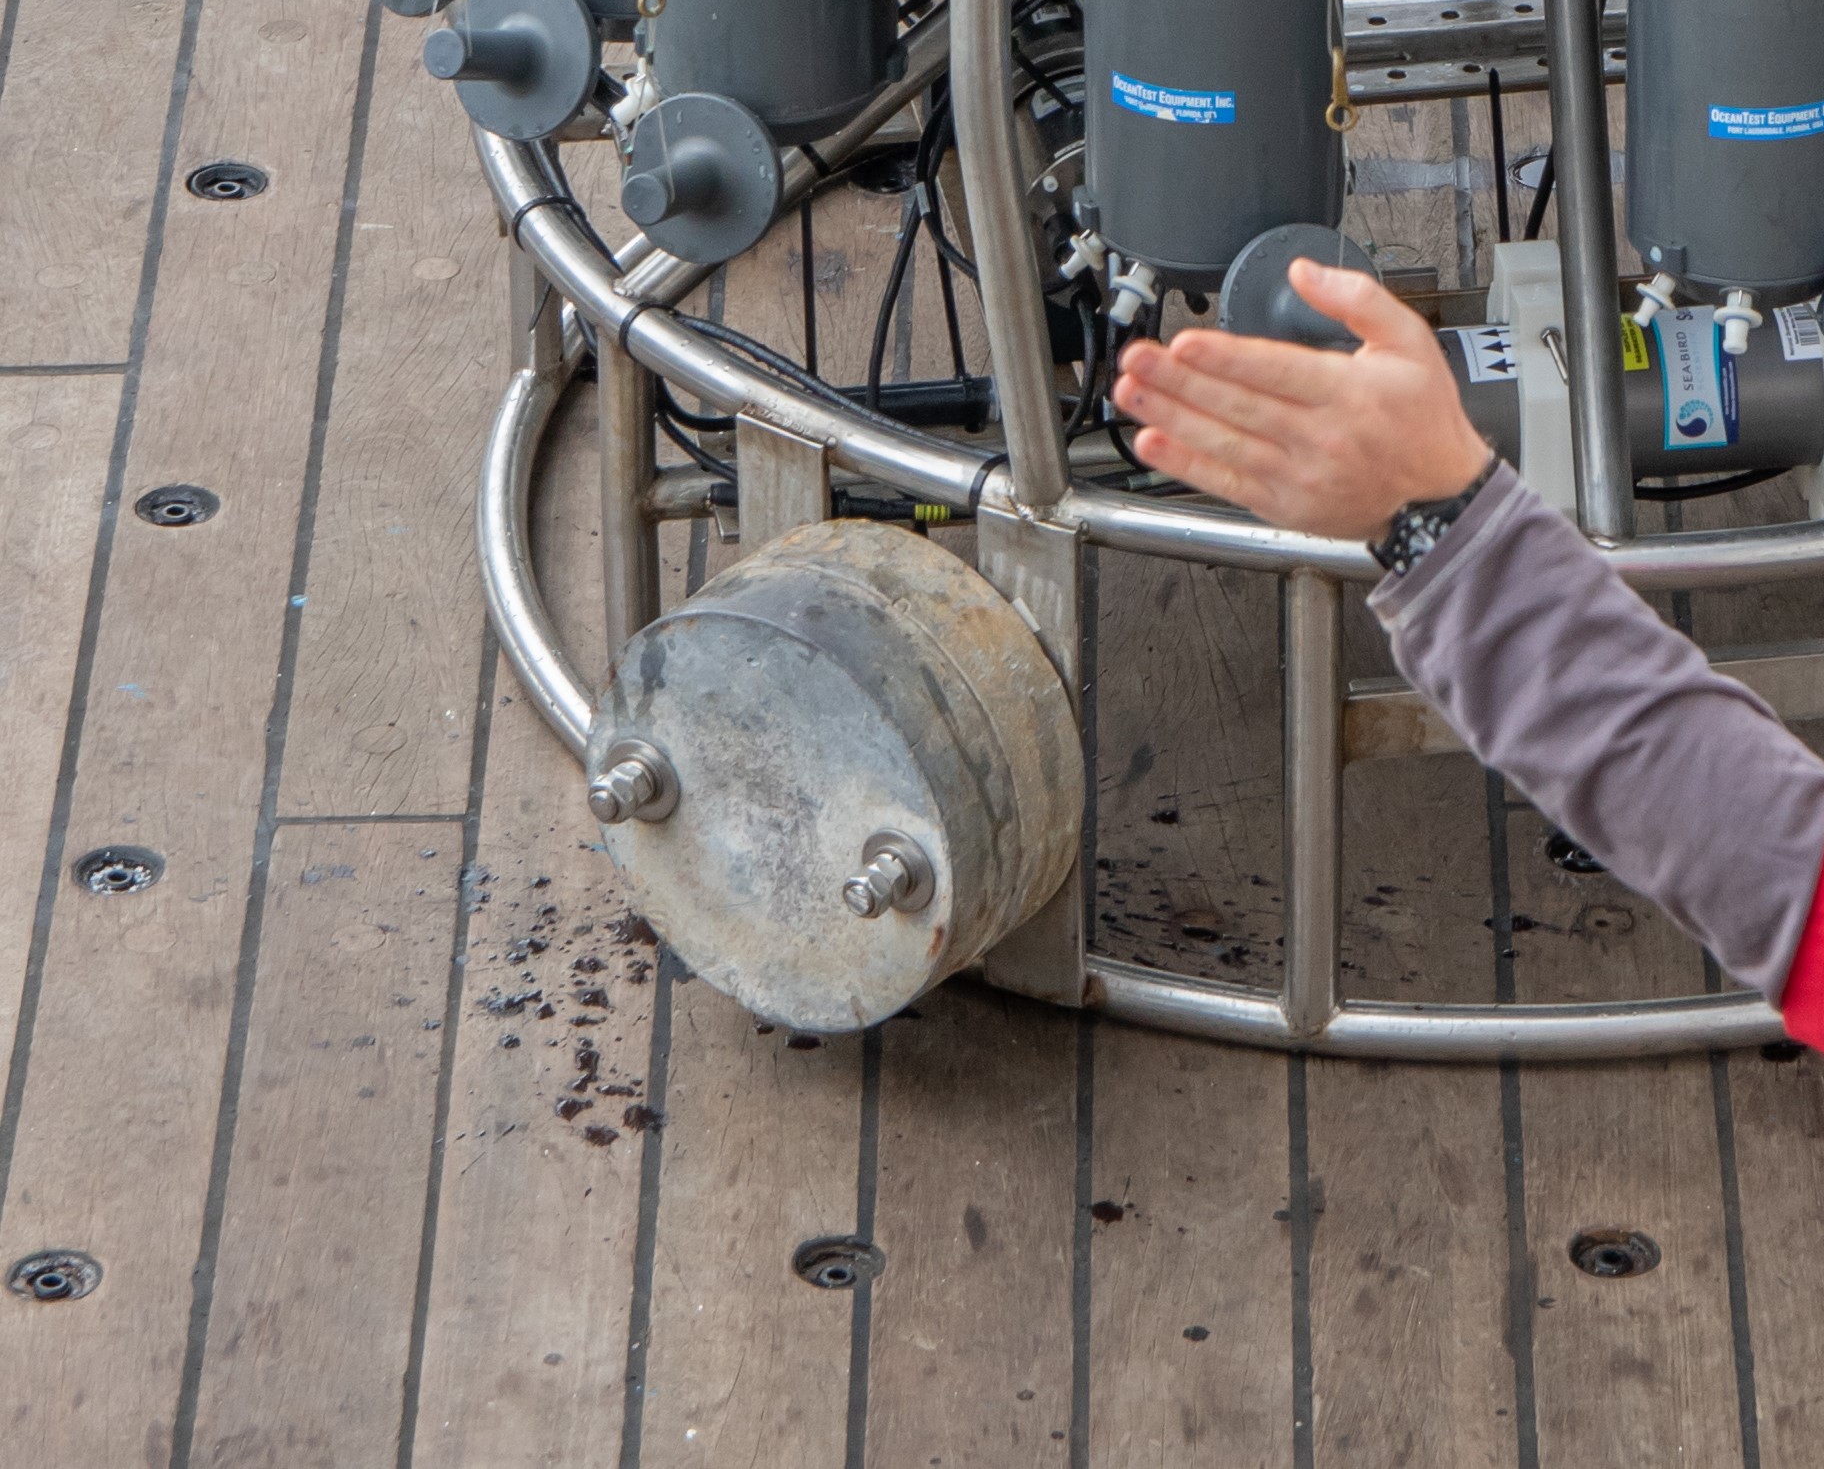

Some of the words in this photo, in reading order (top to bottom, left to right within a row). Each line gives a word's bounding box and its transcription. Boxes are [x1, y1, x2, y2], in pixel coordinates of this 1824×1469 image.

[1113, 75, 1157, 101] OCEANTEST
[1159, 91, 1213, 109] EQUIPMENT,
[1215, 96, 1234, 108] INC.
[1711, 109, 1765, 125] OCEANTEST
[1768, 108, 1820, 125] EQUIPMENT,
